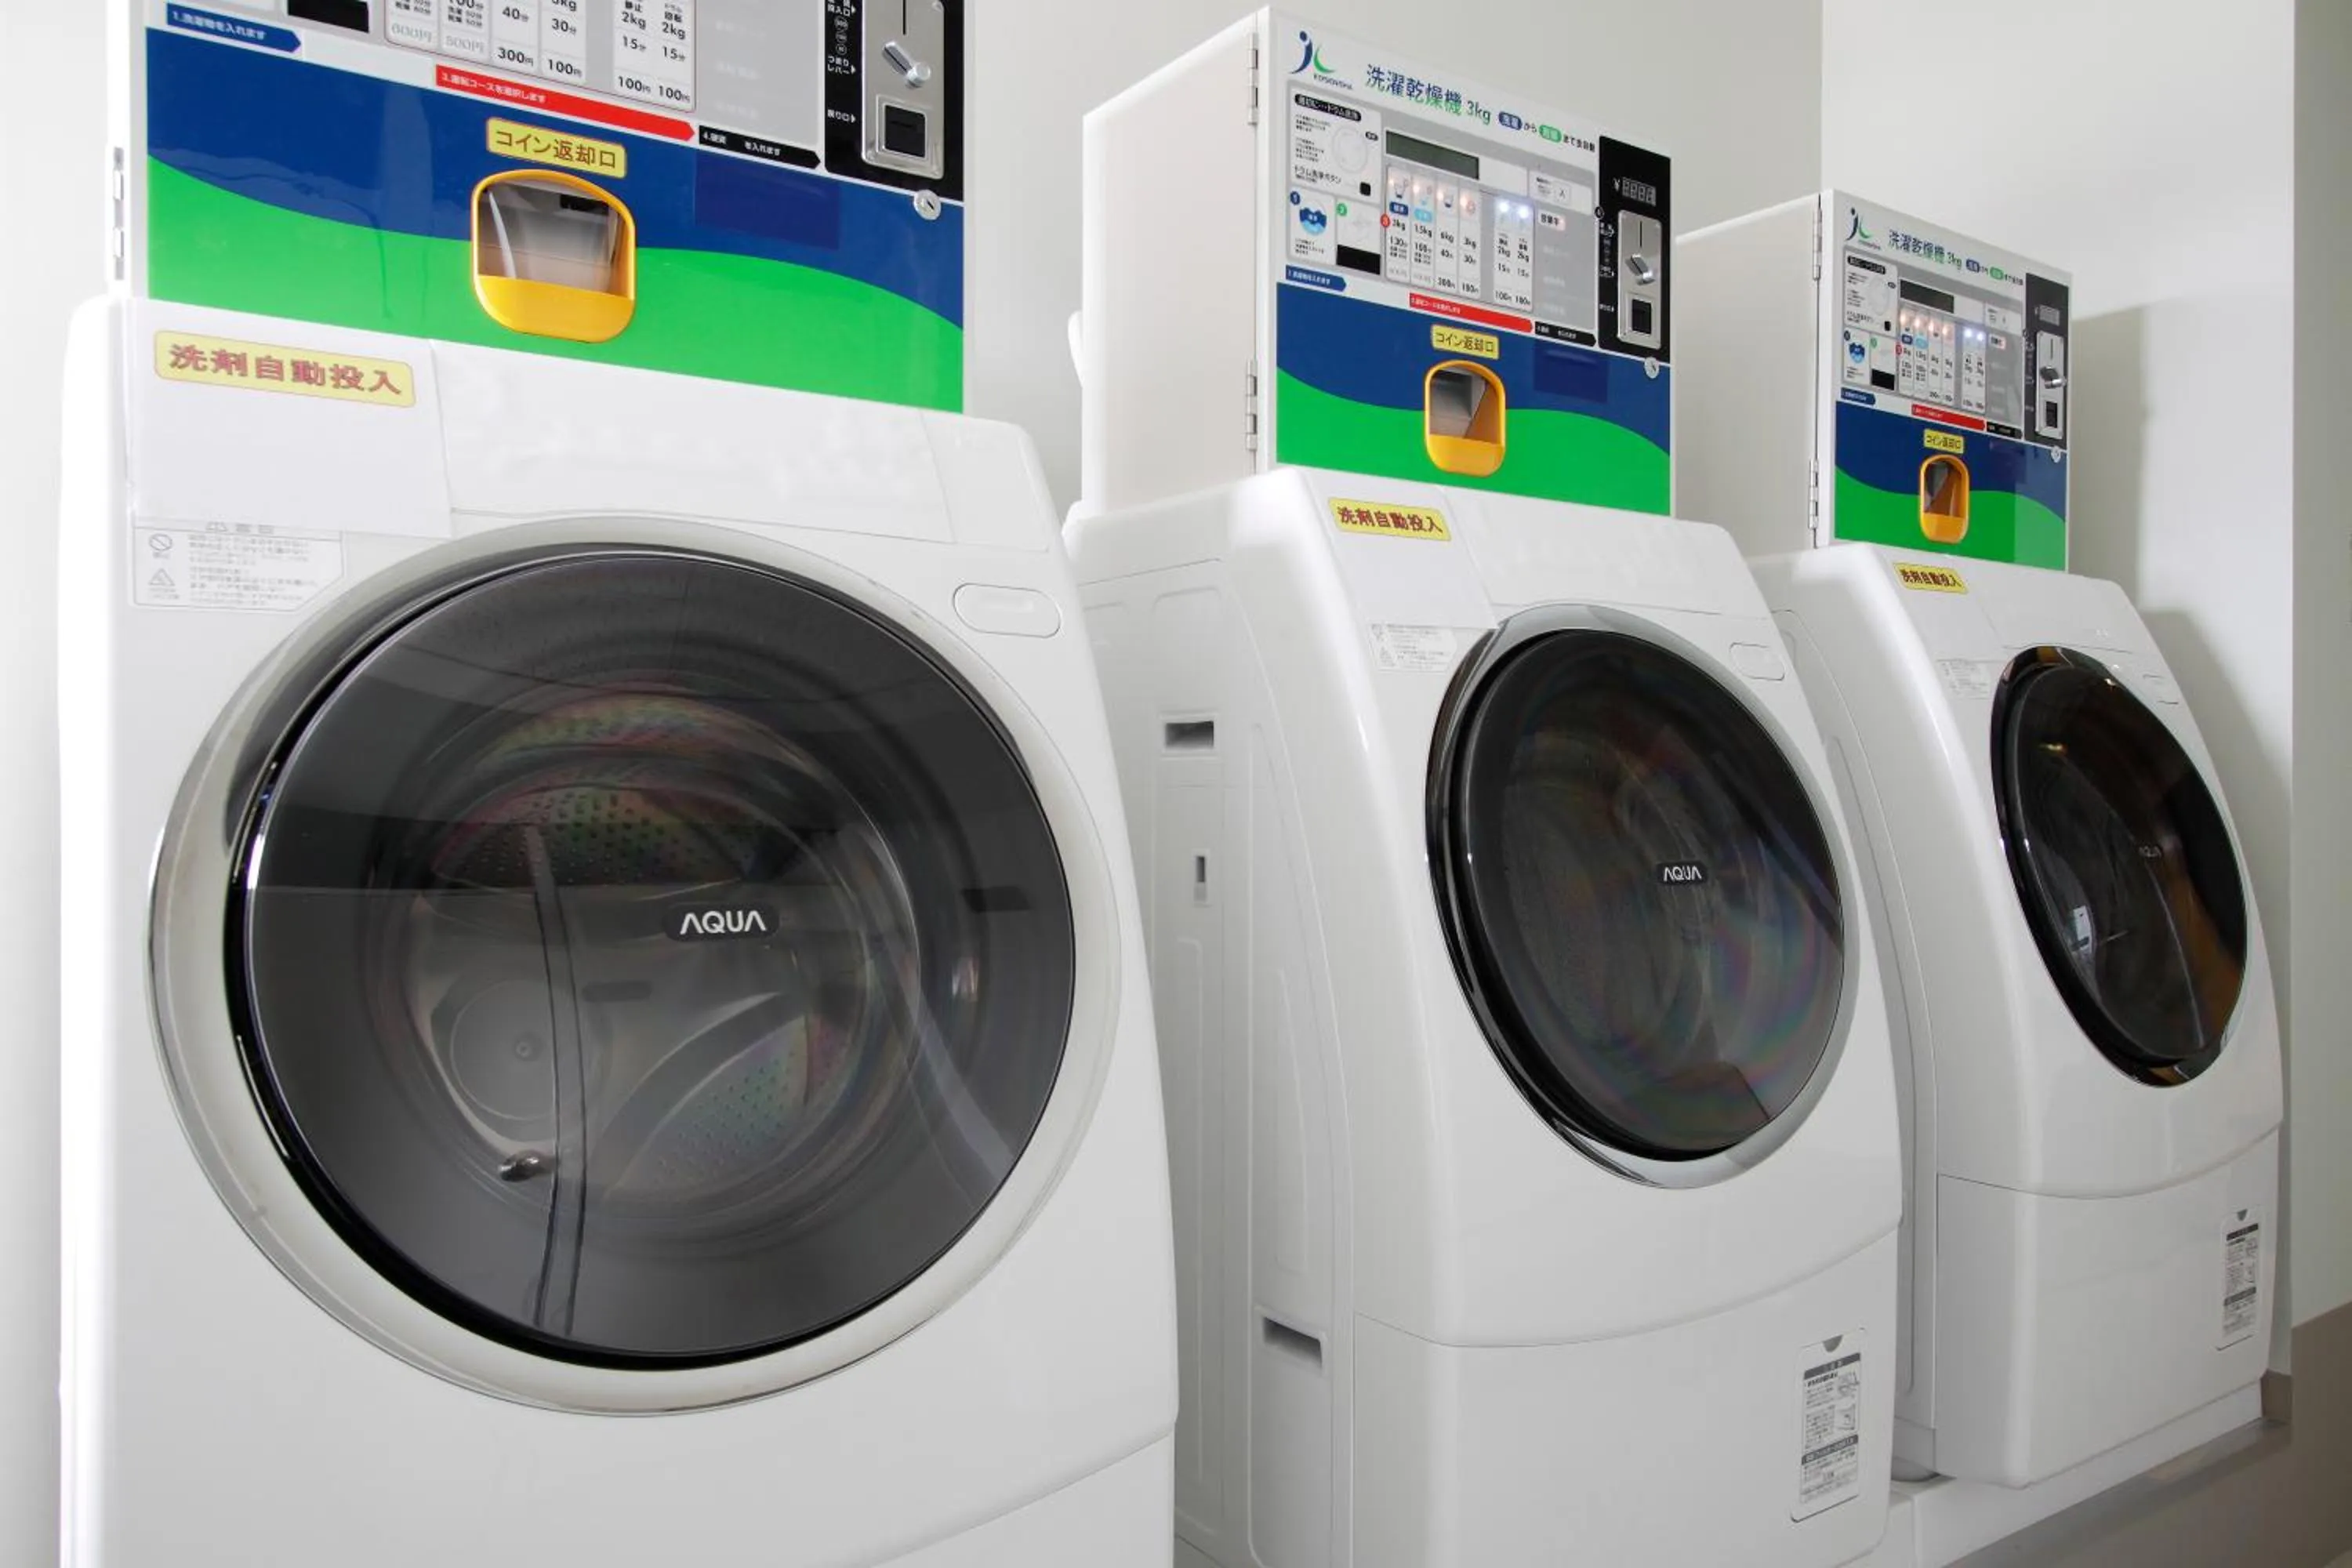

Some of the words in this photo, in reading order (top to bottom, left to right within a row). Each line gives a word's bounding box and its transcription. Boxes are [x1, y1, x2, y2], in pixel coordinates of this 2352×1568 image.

[502, 6, 529, 22] 40分
[621, 11, 647, 30] 2kg
[551, 18, 577, 35] 30分
[662, 21, 686, 40] 2kg
[622, 34, 647, 52] 15分
[497, 46, 534, 67] 300円
[663, 46, 686, 62] 15分
[548, 59, 583, 78] 100円
[618, 75, 652, 93] 100円
[659, 85, 691, 103] 100円
[1366, 63, 1463, 116] 洗濯乾燥機
[1466, 100, 1491, 126] 3kg
[495, 130, 616, 169] コイン返却口
[1436, 332, 1494, 353] コイン返却口
[169, 343, 402, 395] 洗剤自動投入
[1338, 506, 1443, 534] 洗剤自動投入
[1663, 865, 1702, 882] AQUA
[680, 910, 768, 935] AQUA
